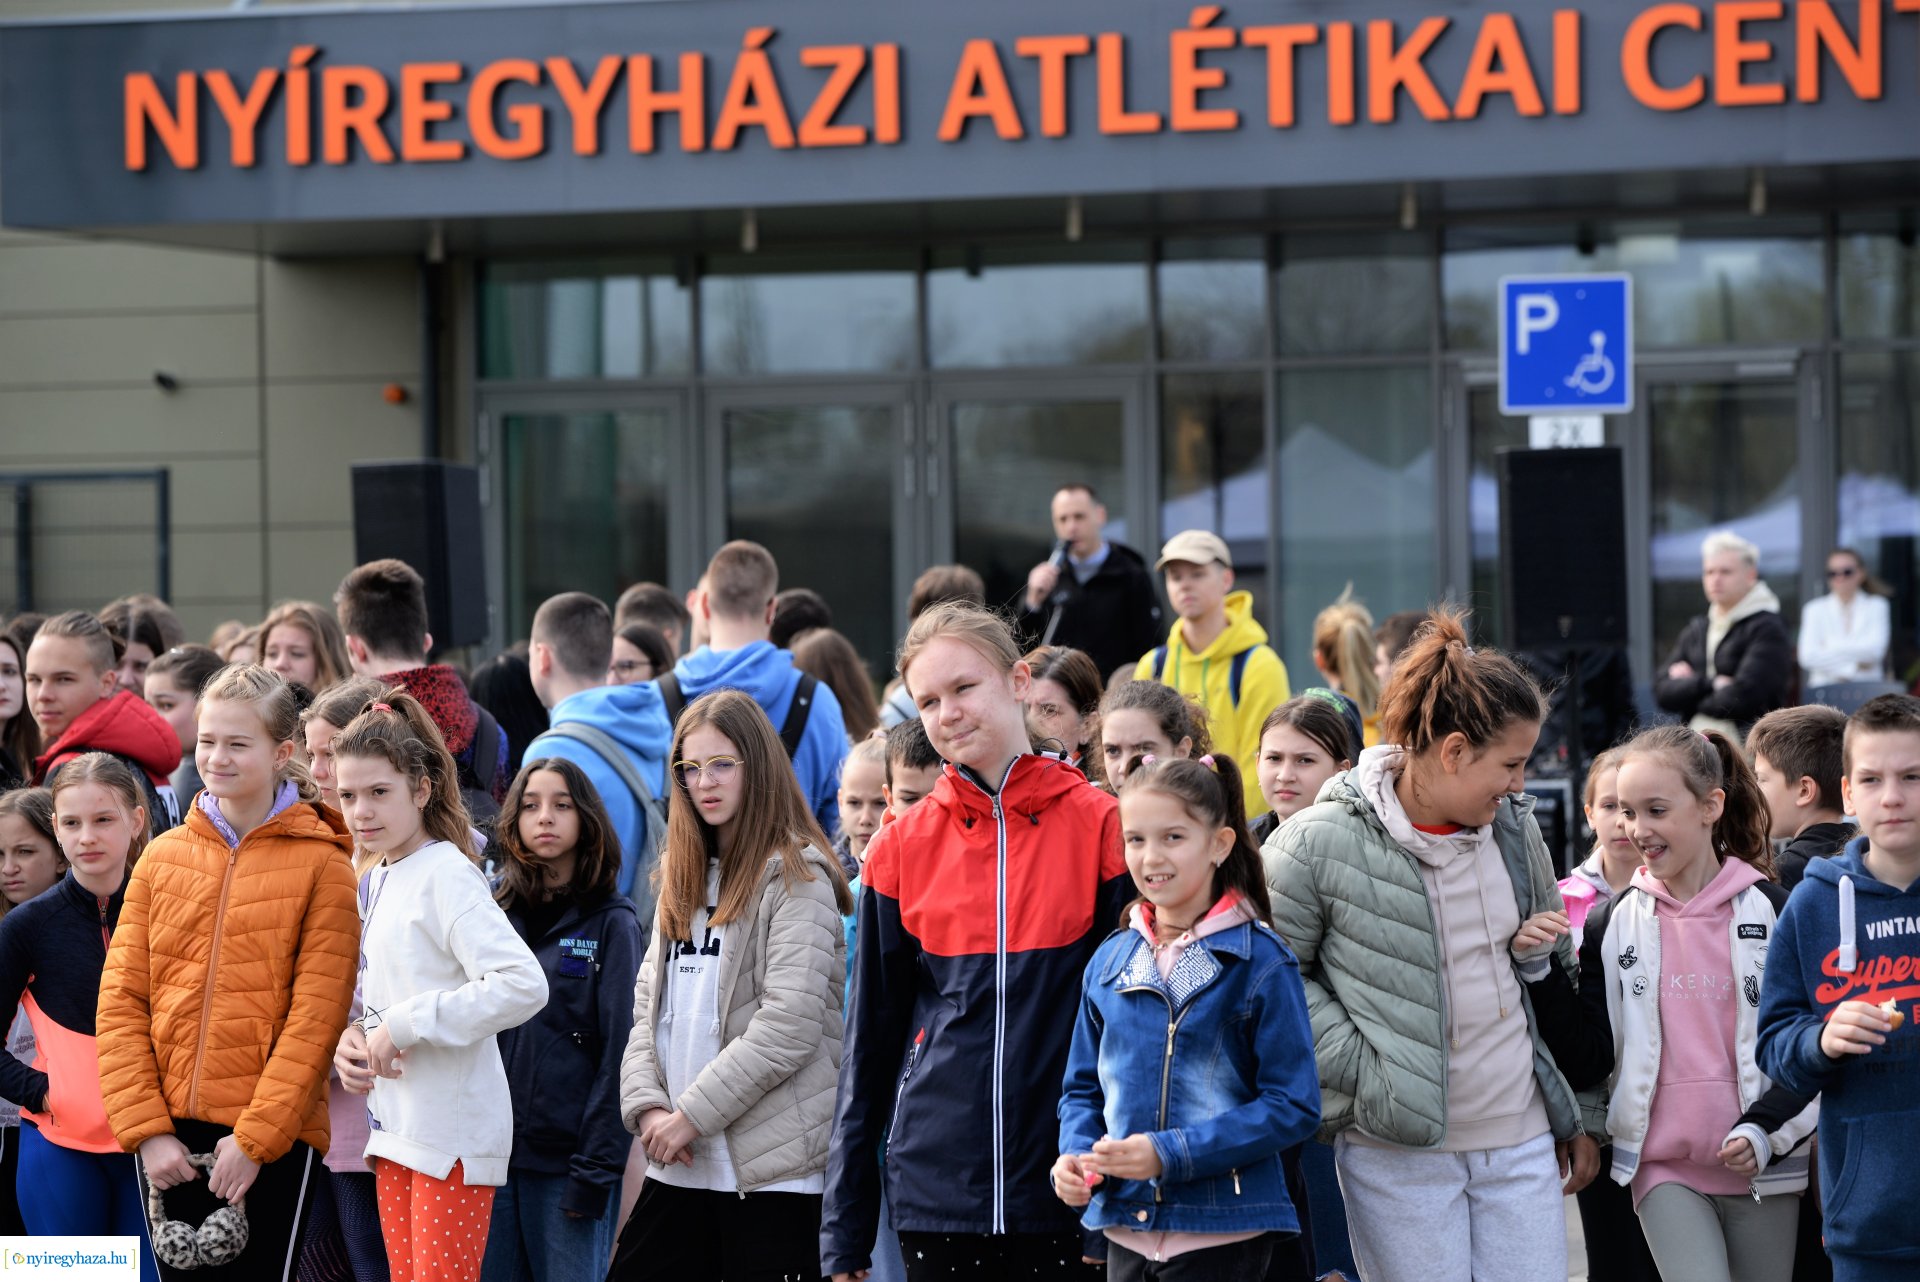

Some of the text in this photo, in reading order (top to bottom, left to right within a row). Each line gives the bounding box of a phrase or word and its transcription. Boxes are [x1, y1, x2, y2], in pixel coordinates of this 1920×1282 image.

[124, 0, 1920, 171] NYÍREGYHÁZI ATLÉTIKAI CEN
[1516, 293, 1560, 355] P
[559, 938, 599, 949] MISS DANCE
[571, 947, 593, 957] NOBLE
